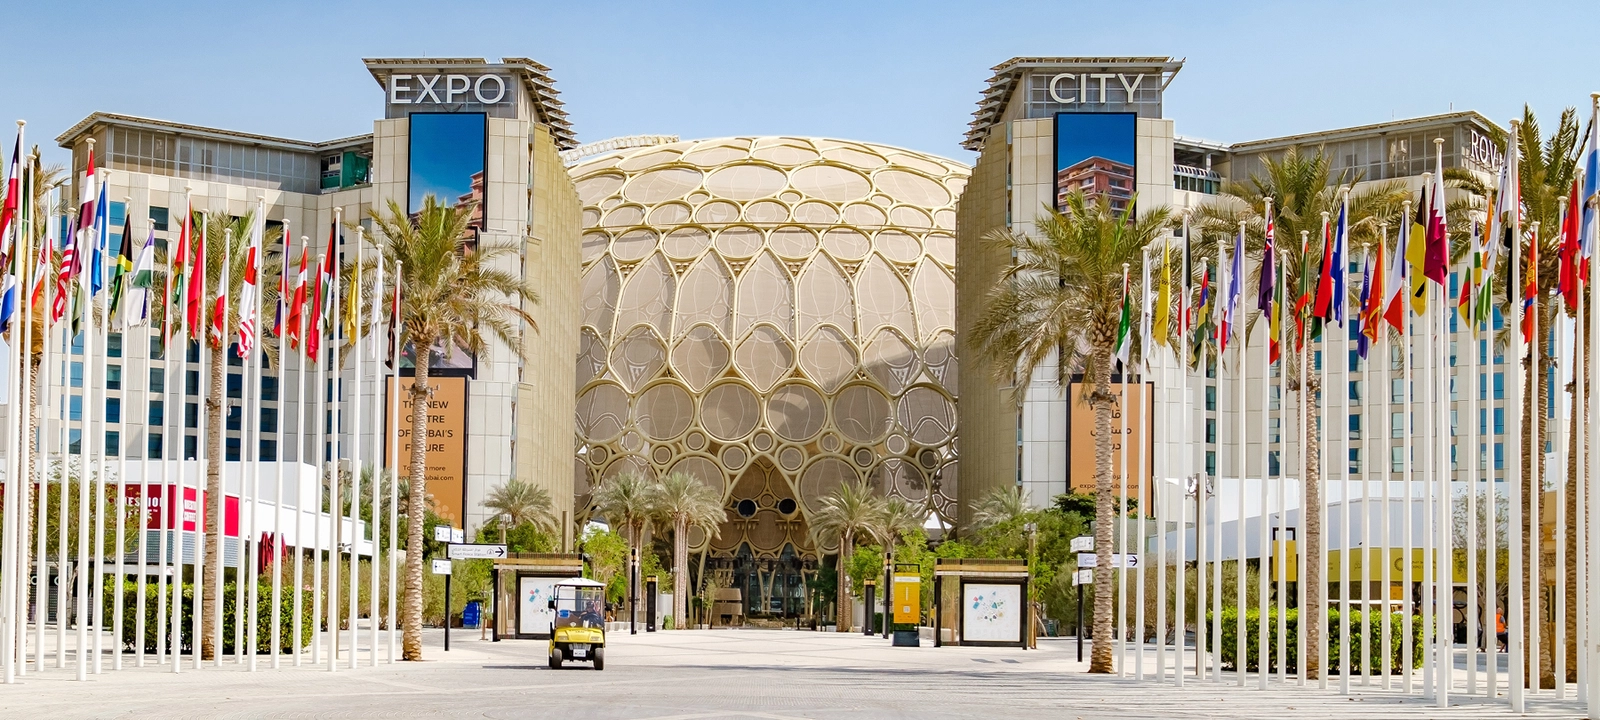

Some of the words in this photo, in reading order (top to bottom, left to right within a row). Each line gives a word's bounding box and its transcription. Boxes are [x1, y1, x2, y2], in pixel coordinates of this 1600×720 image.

[391, 74, 506, 104] EXPO
[1050, 73, 1144, 103] CITY
[405, 415, 445, 423] CTRE
[398, 429, 411, 437] OF
[418, 429, 453, 437] BAI'S
[405, 444, 445, 452] FURE
